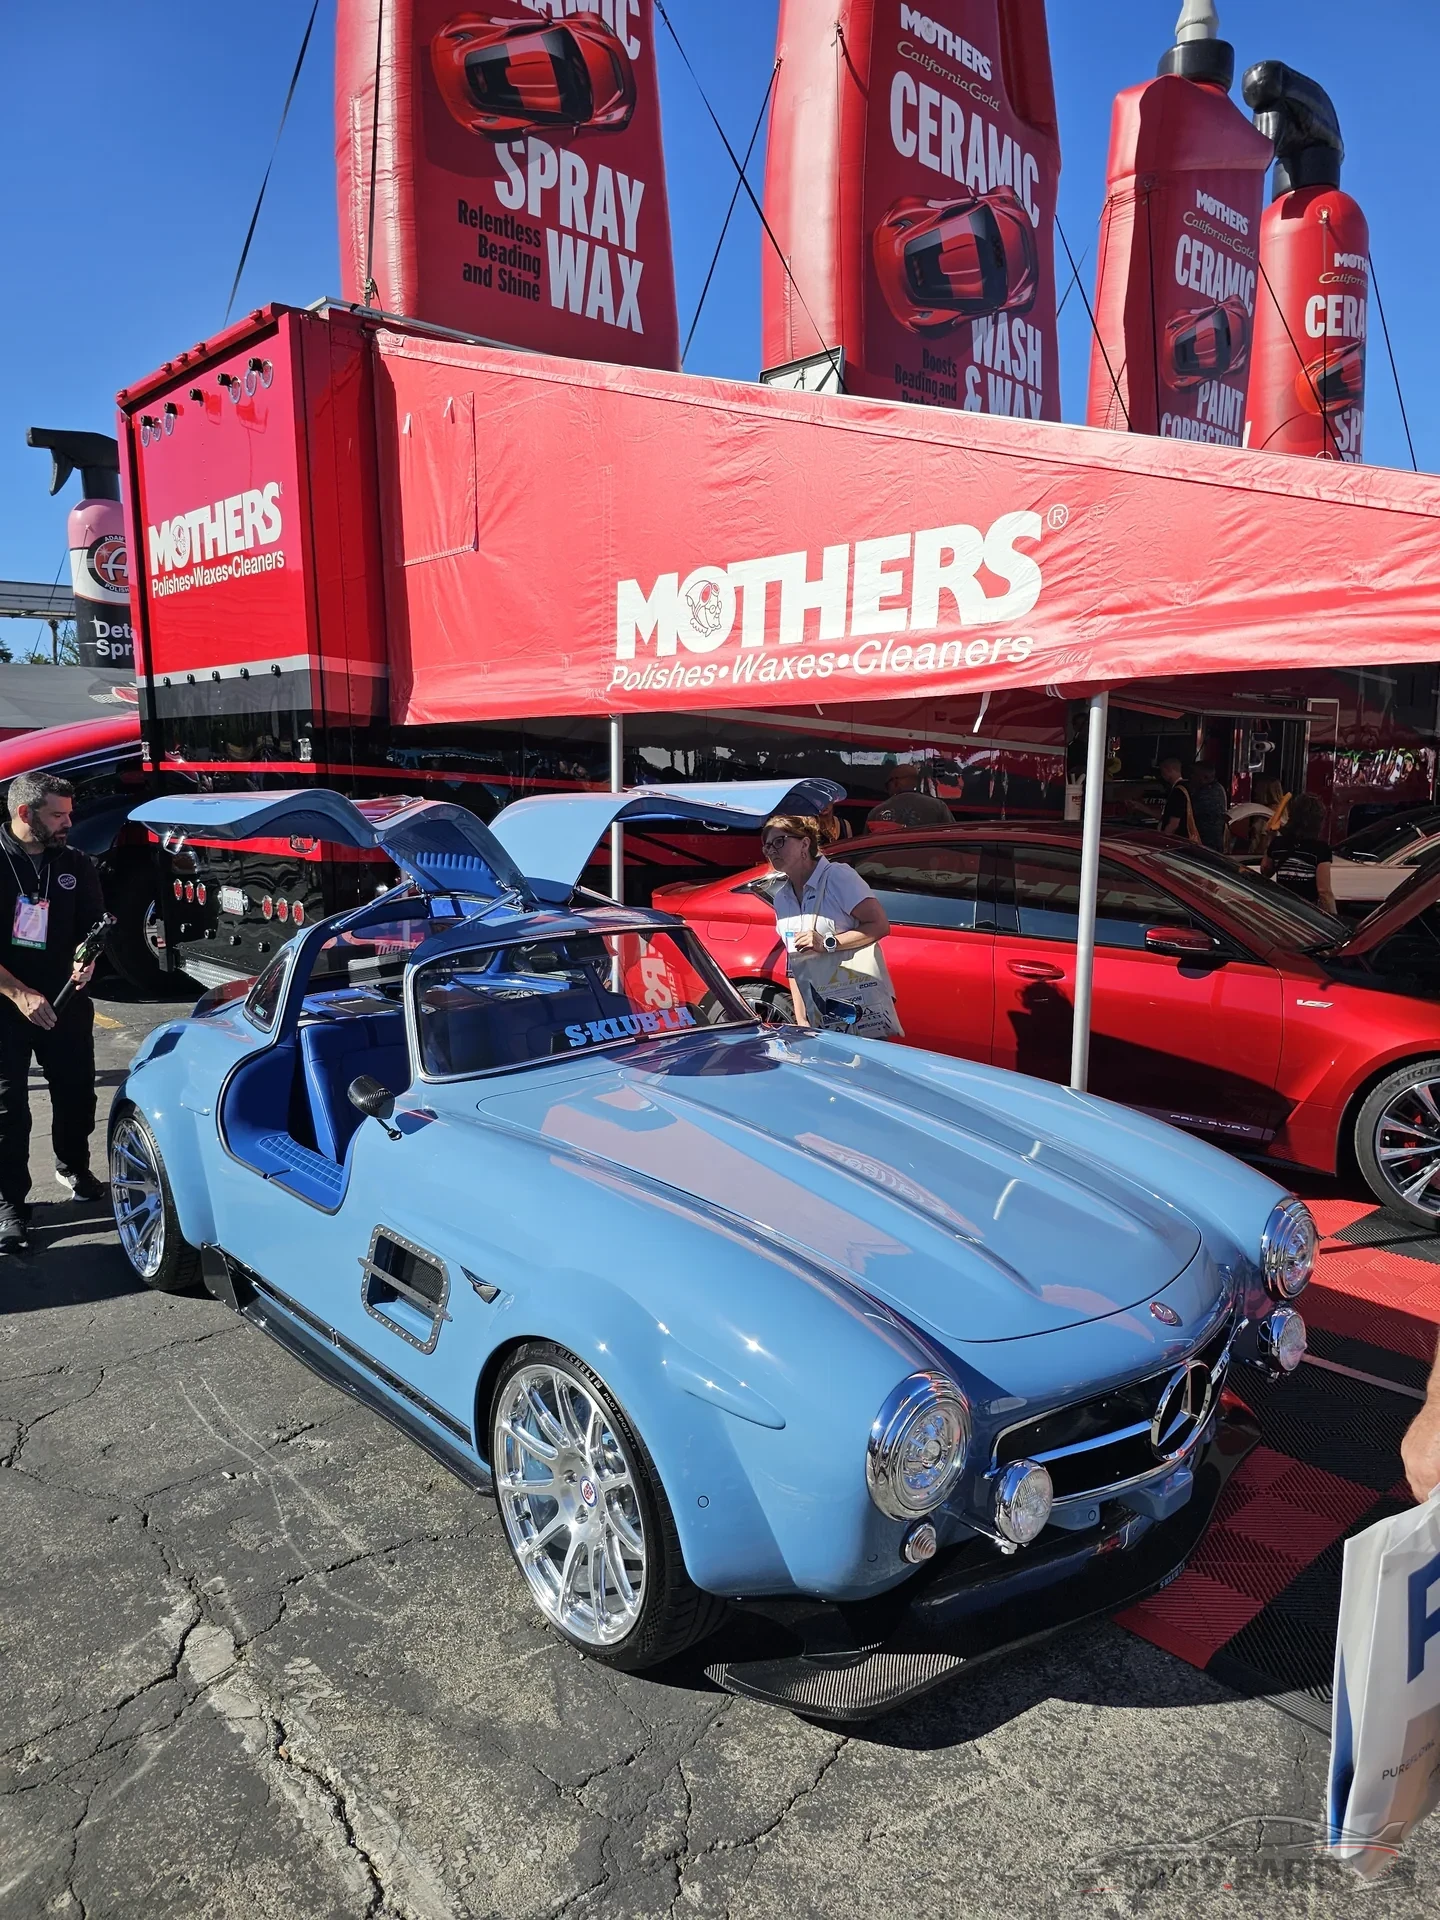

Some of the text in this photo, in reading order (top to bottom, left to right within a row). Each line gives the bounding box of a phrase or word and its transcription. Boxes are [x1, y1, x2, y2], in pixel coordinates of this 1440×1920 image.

[900, 3, 992, 82] MOTHERS
[890, 70, 1040, 228] CERAMIC
[457, 198, 542, 249] Relentless
[494, 136, 645, 252] SPRAY
[1196, 189, 1249, 236] MOTHERS
[463, 261, 541, 302] and Shine
[477, 235, 542, 281] Beading
[546, 227, 644, 335] WAX
[1175, 234, 1255, 318] CERAMIC
[922, 348, 958, 379] Boosts
[971, 310, 1042, 390] WASH
[939, 381, 957, 402] and
[1196, 380, 1244, 434] PAINT
[1334, 407, 1364, 452] SP
[148, 481, 282, 576] MOTHERS
[557, 1346, 603, 1389] MICHELIN
[603, 1392, 618, 1413] PILOT
[616, 1412, 632, 1438] SPORT
